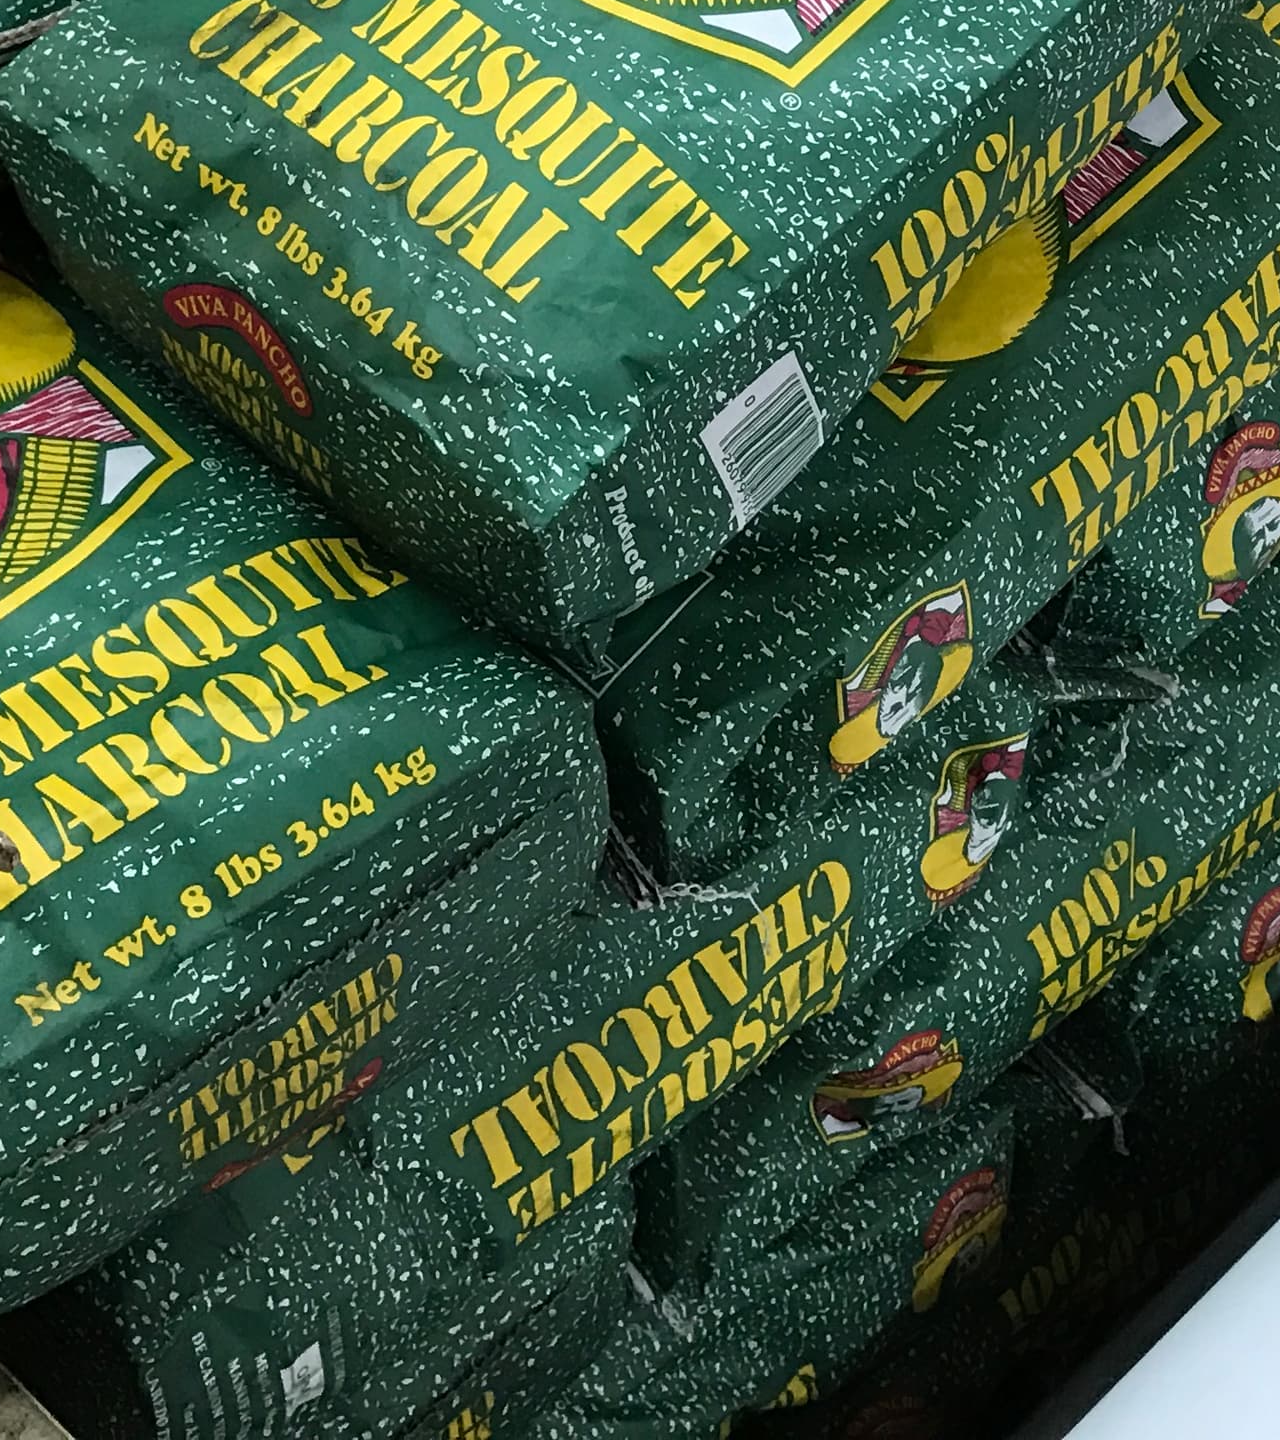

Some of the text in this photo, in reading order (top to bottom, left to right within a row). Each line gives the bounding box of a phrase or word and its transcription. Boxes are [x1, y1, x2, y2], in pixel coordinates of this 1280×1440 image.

[133, 113, 444, 381] Net wt. 8 lbs 3.64 kg
[871, 114, 1032, 310] 100%
[175, 294, 307, 409] VIVA PANCHO
[605, 485, 647, 575] Product
[1208, 425, 1276, 495] VIVA PANCHO
[14, 746, 438, 1028] Net wt. 8 lbs 3.64 kg
[1026, 827, 1169, 976] 100%
[1246, 919, 1263, 955] VIVA
[169, 954, 405, 1138] CHARCOAL
[179, 992, 400, 1170] MESQUITE
[451, 861, 853, 1189] CHARCOAL
[508, 916, 853, 1246] MESQUITE
[886, 1035, 938, 1071] PANCHO
